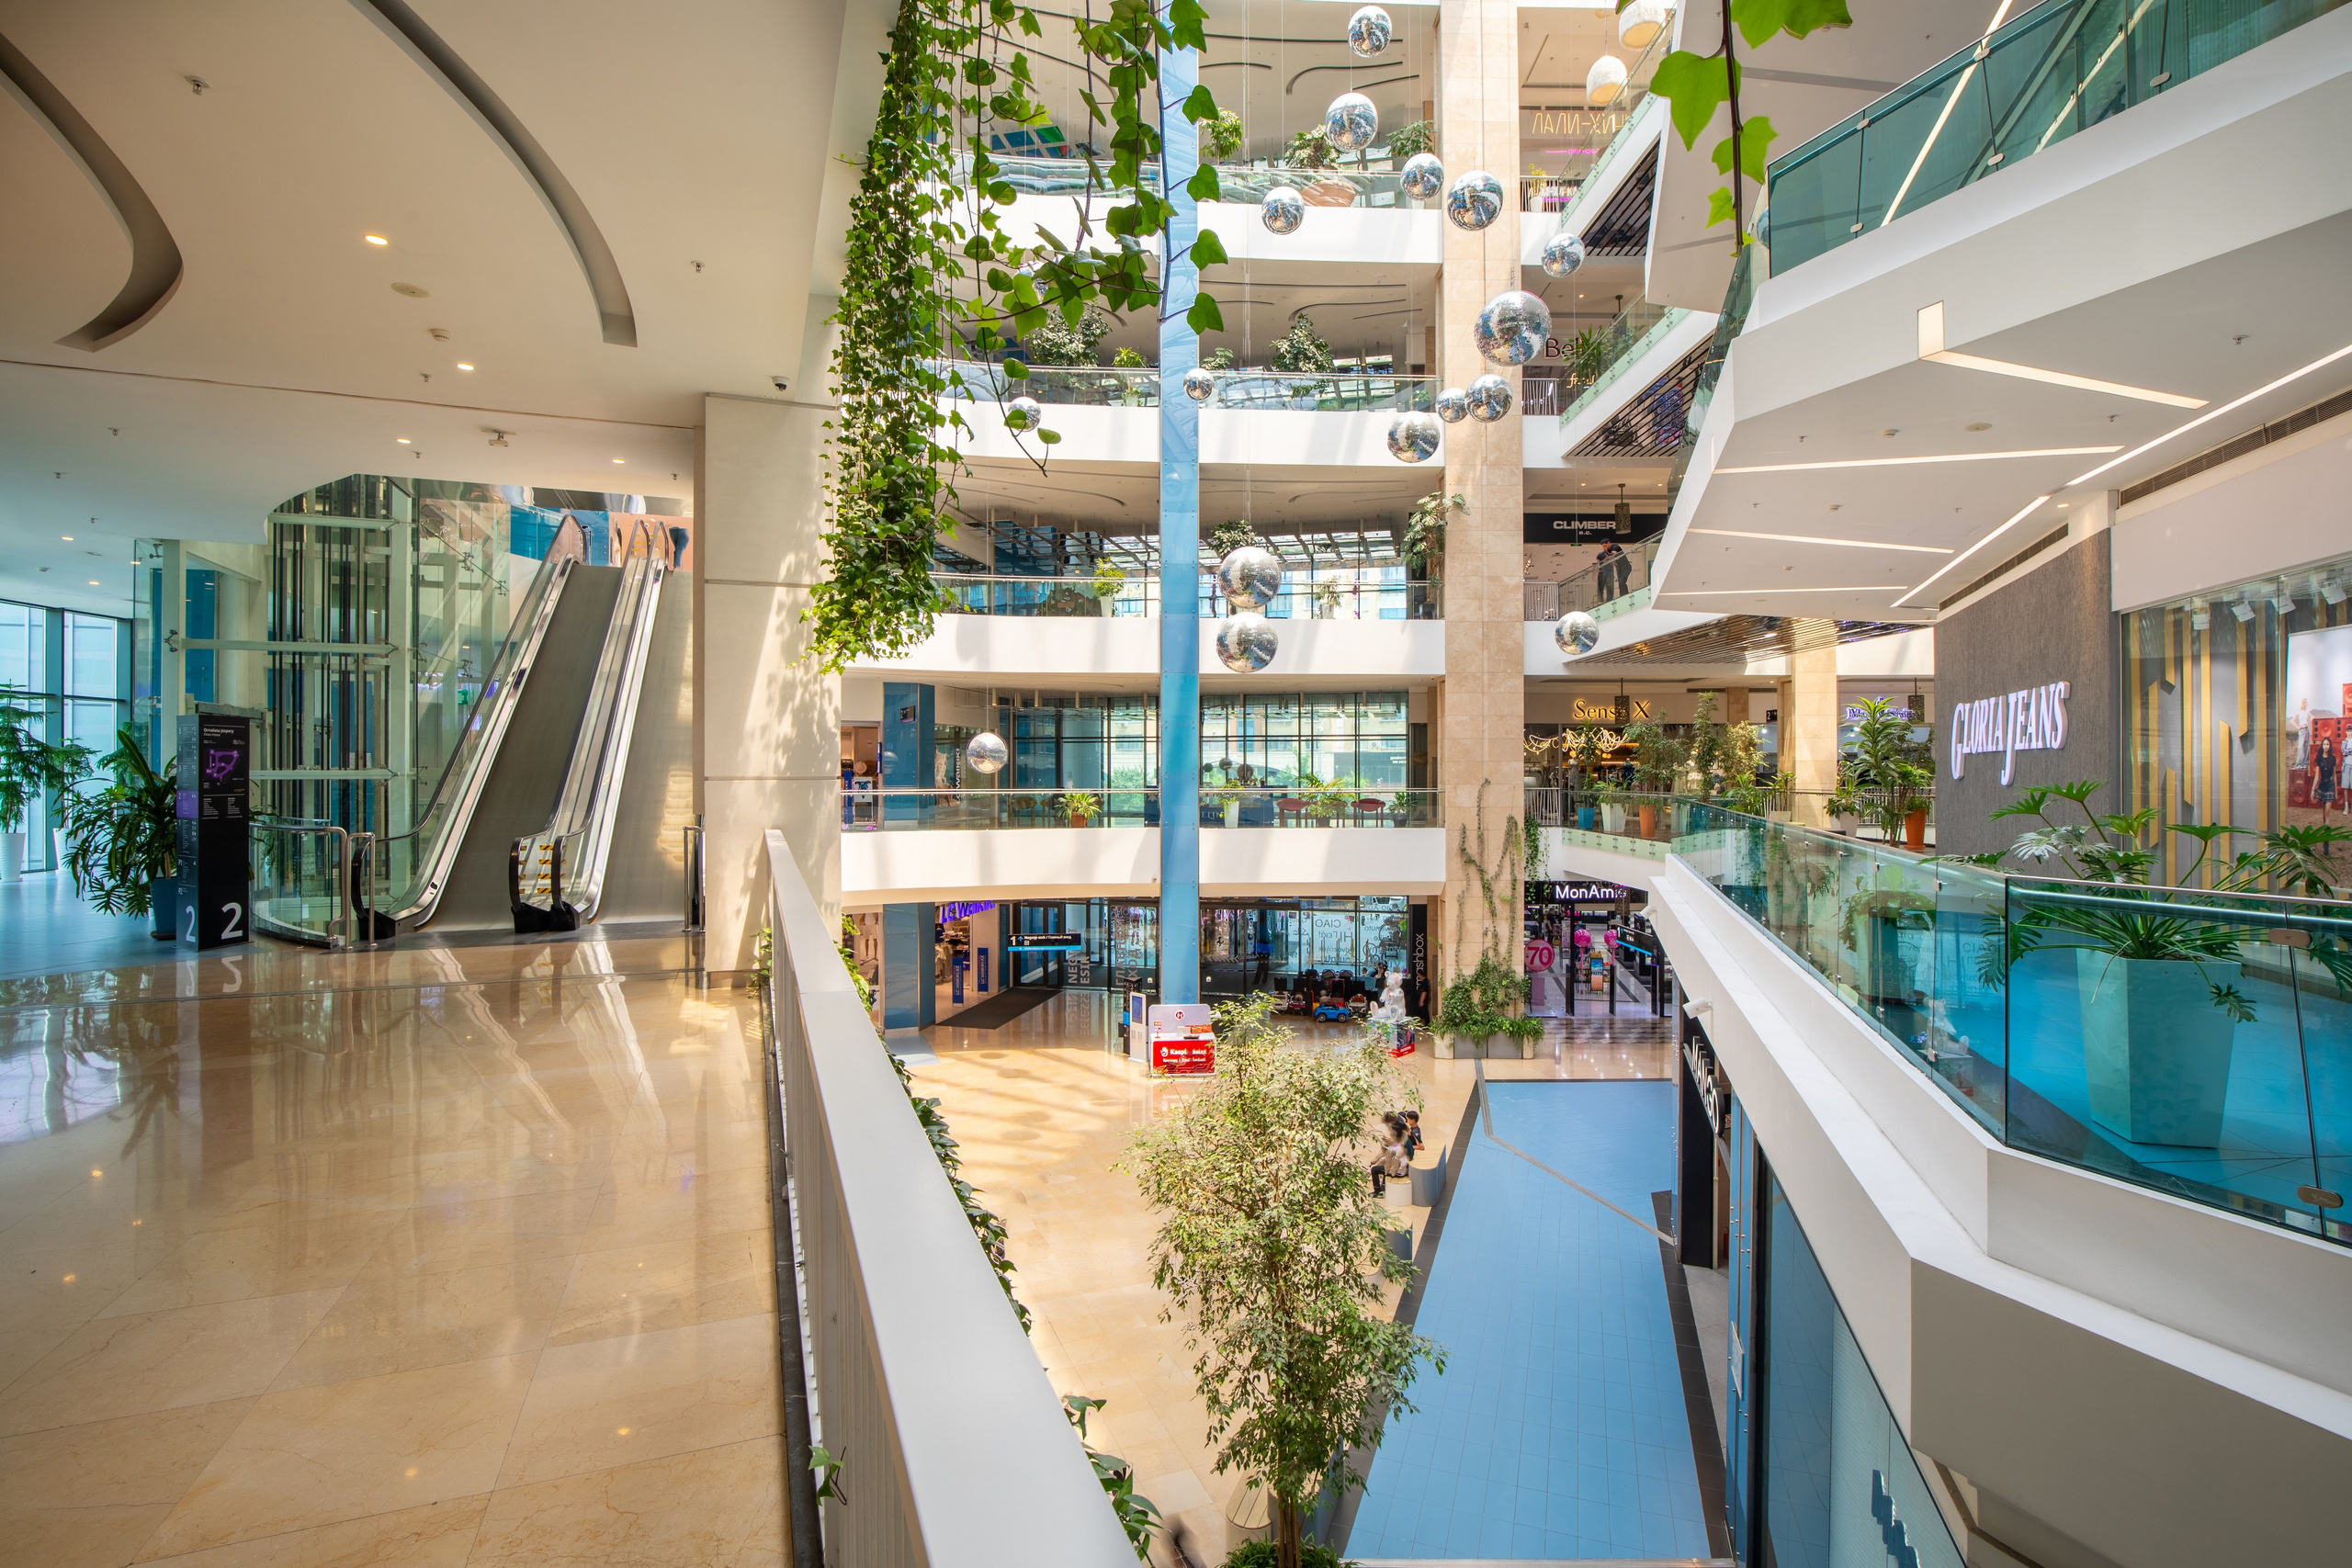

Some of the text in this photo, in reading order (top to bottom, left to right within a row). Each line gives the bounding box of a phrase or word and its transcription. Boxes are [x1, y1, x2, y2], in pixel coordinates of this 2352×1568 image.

[1553, 520, 1616, 530] CLIMBER
[1574, 699, 1650, 719] Sens X
[1951, 681, 2071, 786] GLORIA JEANS
[186, 905, 197, 943] 2
[220, 902, 243, 940] 2
[941, 902, 956, 924] LC
[1010, 935, 1016, 946] 1
[1128, 948, 1140, 979] ХОД
[1691, 1035, 1725, 1137] MANGO
